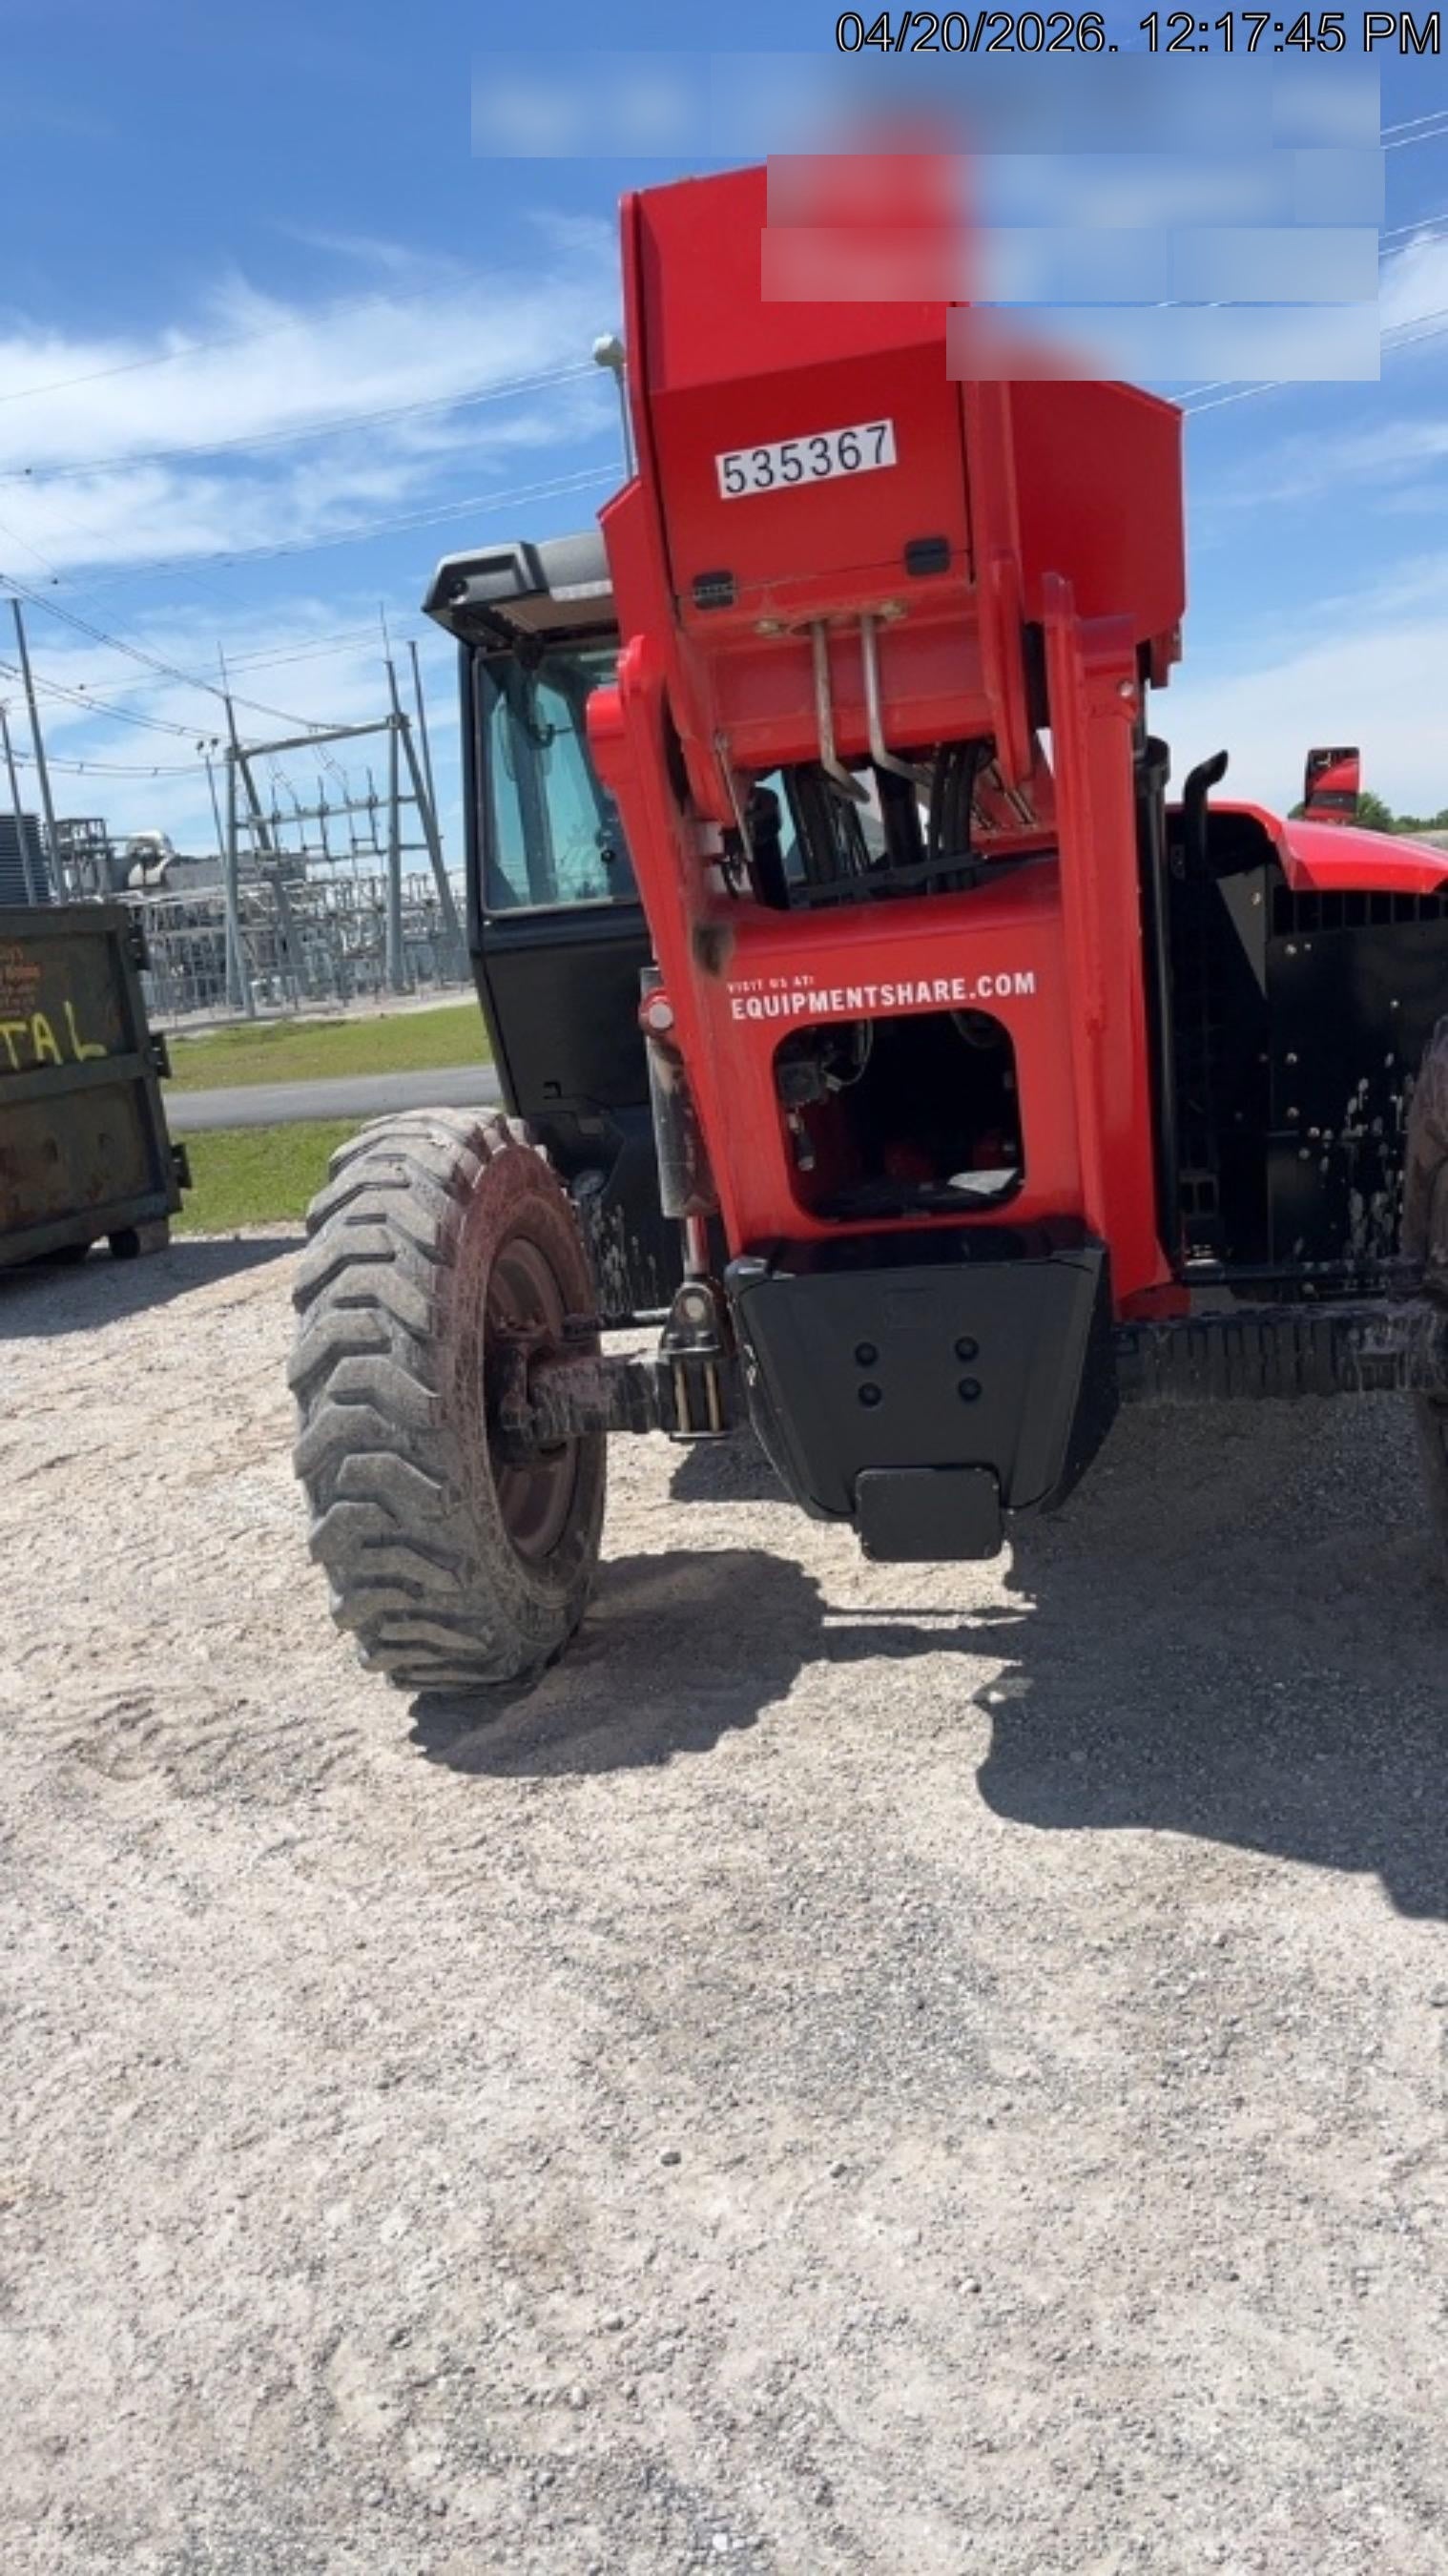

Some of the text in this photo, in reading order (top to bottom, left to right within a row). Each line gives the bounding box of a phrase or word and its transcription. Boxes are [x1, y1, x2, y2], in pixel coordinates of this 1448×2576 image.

[722, 423, 888, 494] 535367
[726, 978, 763, 993] VISIT
[769, 977, 788, 988] US
[730, 971, 1036, 1020] EQUIPMENTSHARE.COM
